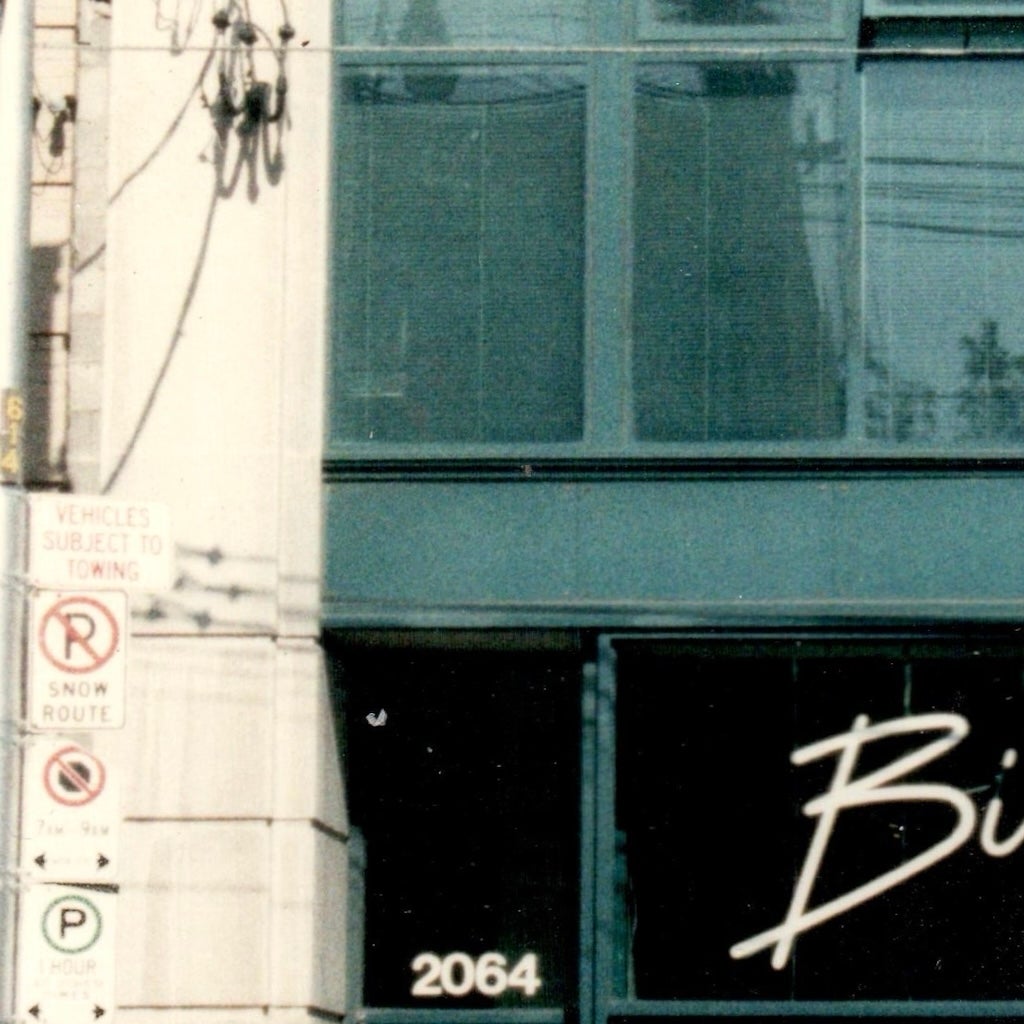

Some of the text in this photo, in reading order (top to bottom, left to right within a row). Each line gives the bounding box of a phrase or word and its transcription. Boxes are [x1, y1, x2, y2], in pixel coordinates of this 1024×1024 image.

[55, 503, 151, 528] VEHICLES
[42, 530, 163, 556] SUBJECT TO
[66, 558, 140, 582] TOWING
[48, 681, 109, 698] SNOW
[42, 704, 112, 723] ROUTE
[49, 957, 98, 977] HOUR
[411, 951, 542, 997] 2064
